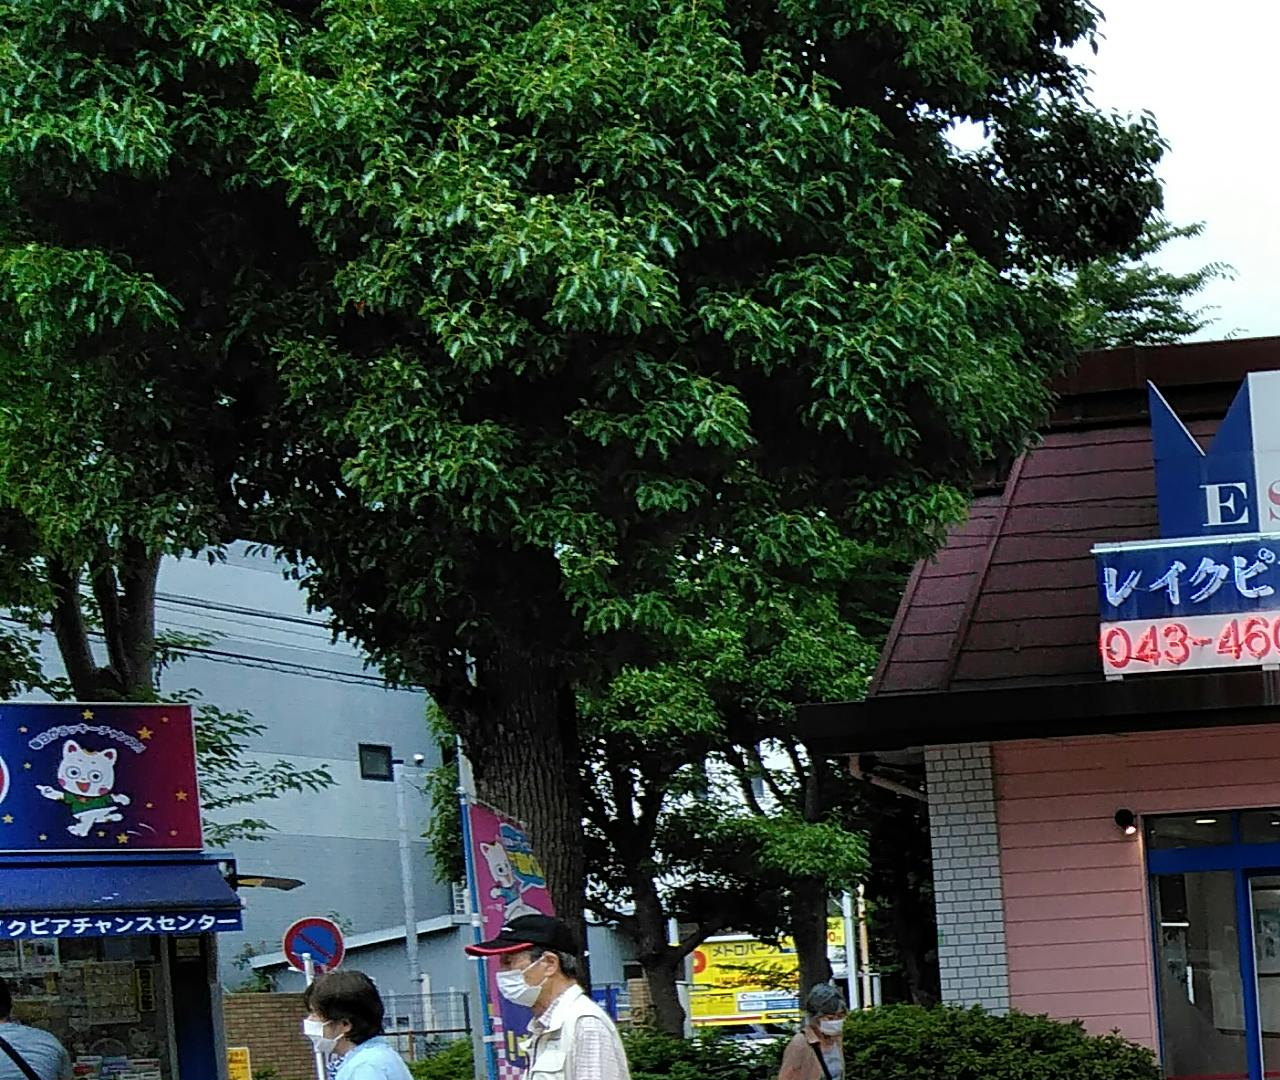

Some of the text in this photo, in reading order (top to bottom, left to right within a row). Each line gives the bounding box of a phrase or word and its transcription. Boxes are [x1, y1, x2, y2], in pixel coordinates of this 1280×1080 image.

[0, 914, 239, 938] クピアチャンスセンター
